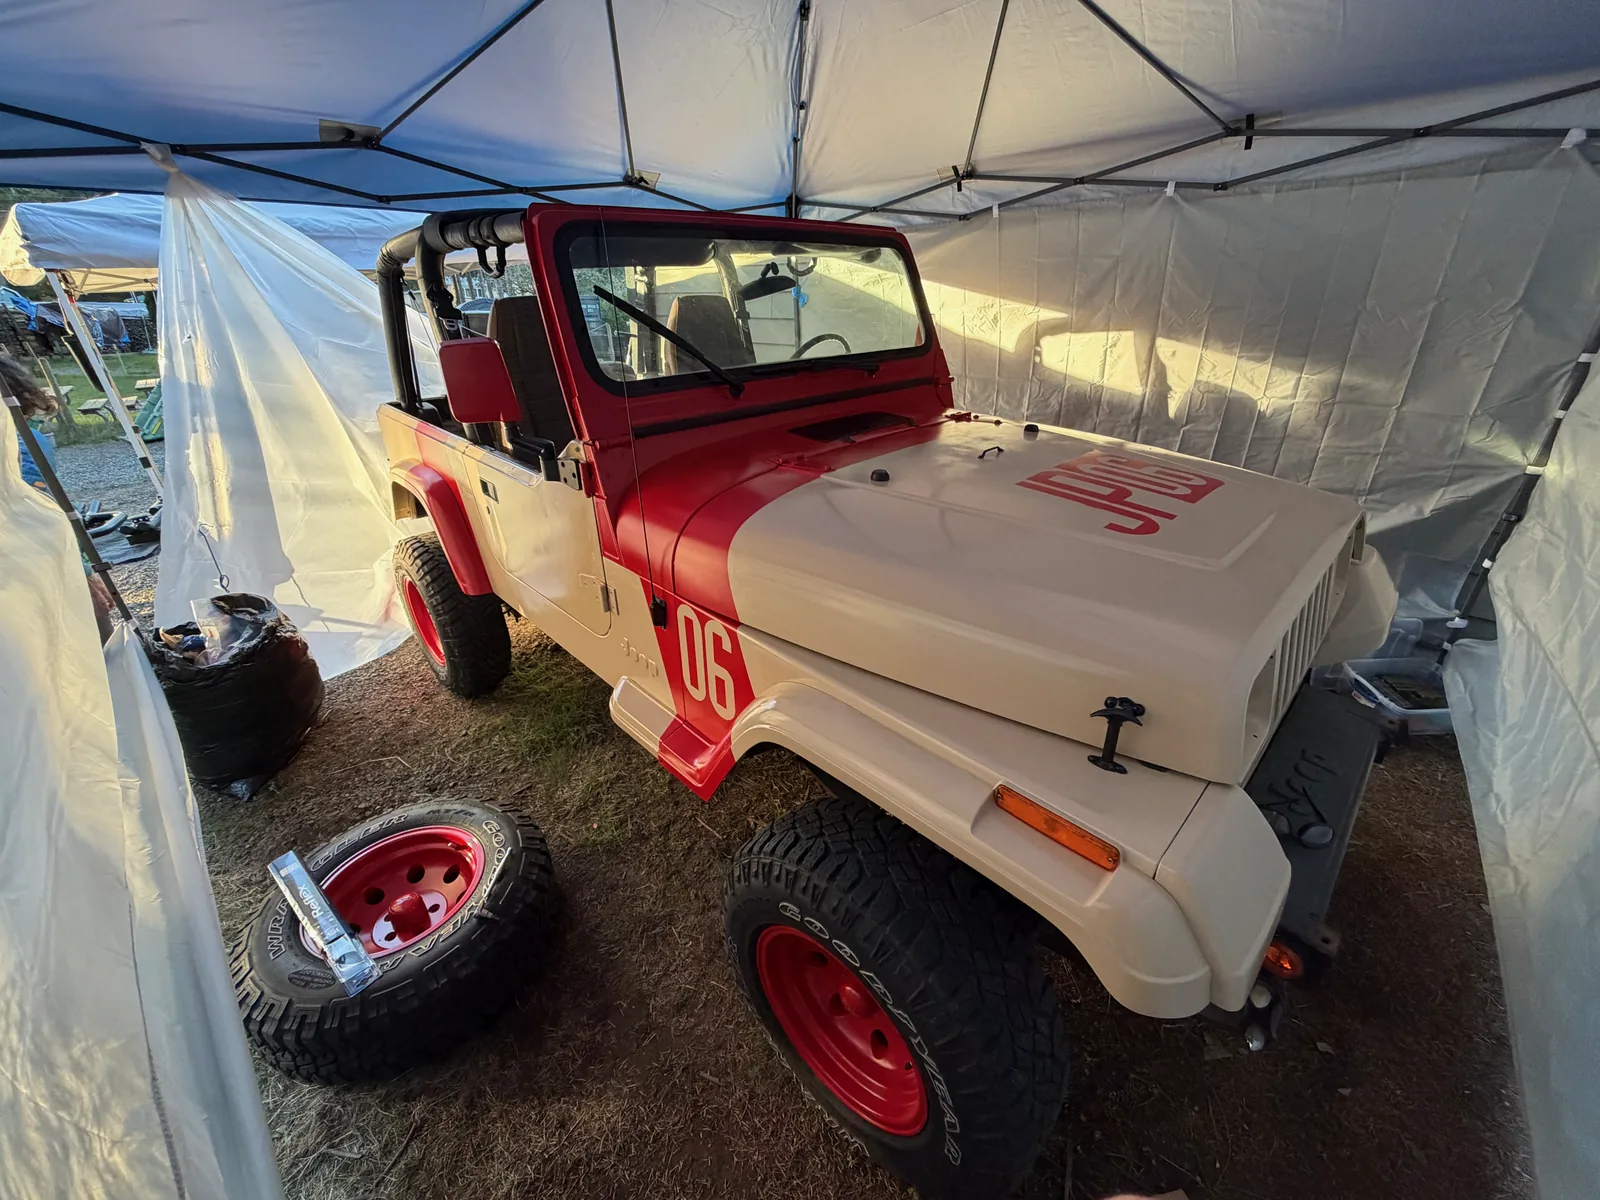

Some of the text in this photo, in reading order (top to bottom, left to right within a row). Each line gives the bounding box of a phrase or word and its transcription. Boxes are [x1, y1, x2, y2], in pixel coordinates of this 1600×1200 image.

[676, 604, 736, 721] 06
[267, 813, 408, 960] WRAGLER
[297, 883, 325, 919] Reflex
[779, 902, 962, 1166] GOODYEAR
